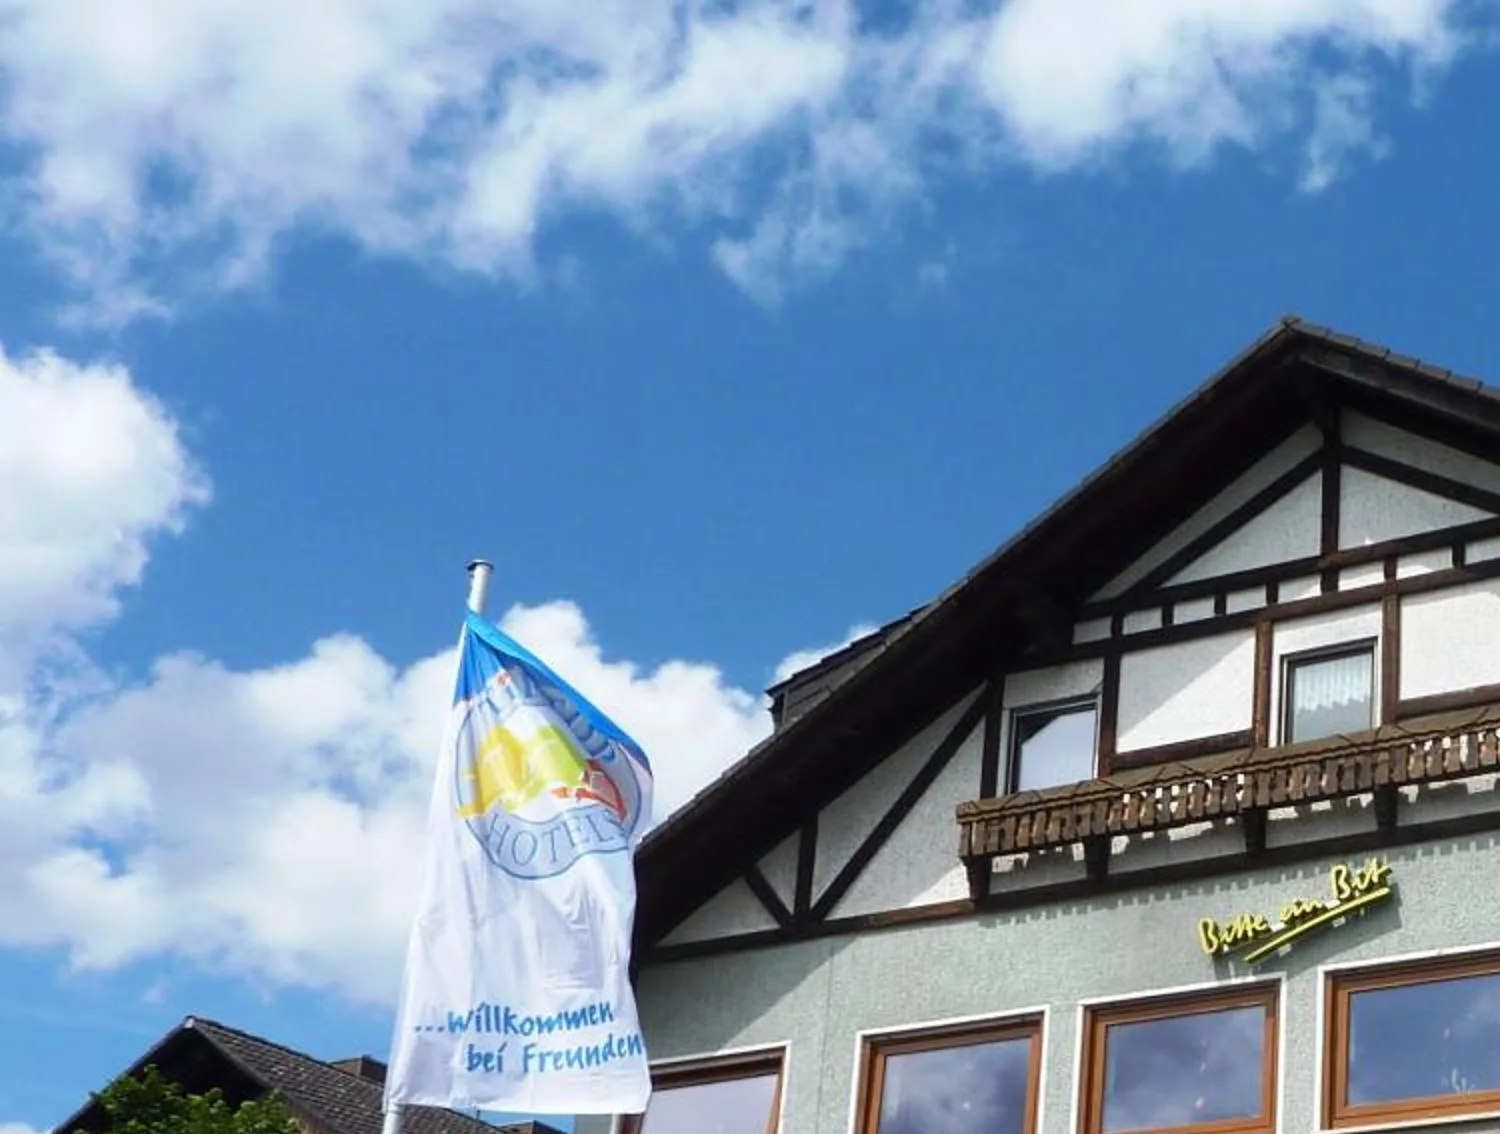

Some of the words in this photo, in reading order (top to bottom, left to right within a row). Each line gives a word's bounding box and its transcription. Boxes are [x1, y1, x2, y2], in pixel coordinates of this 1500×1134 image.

[1198, 911, 1268, 956] Bitte
[1279, 897, 1324, 922] ein
[1330, 855, 1392, 900] Bit
[467, 1042, 508, 1073] bei
[522, 1033, 643, 1073] Freunden
